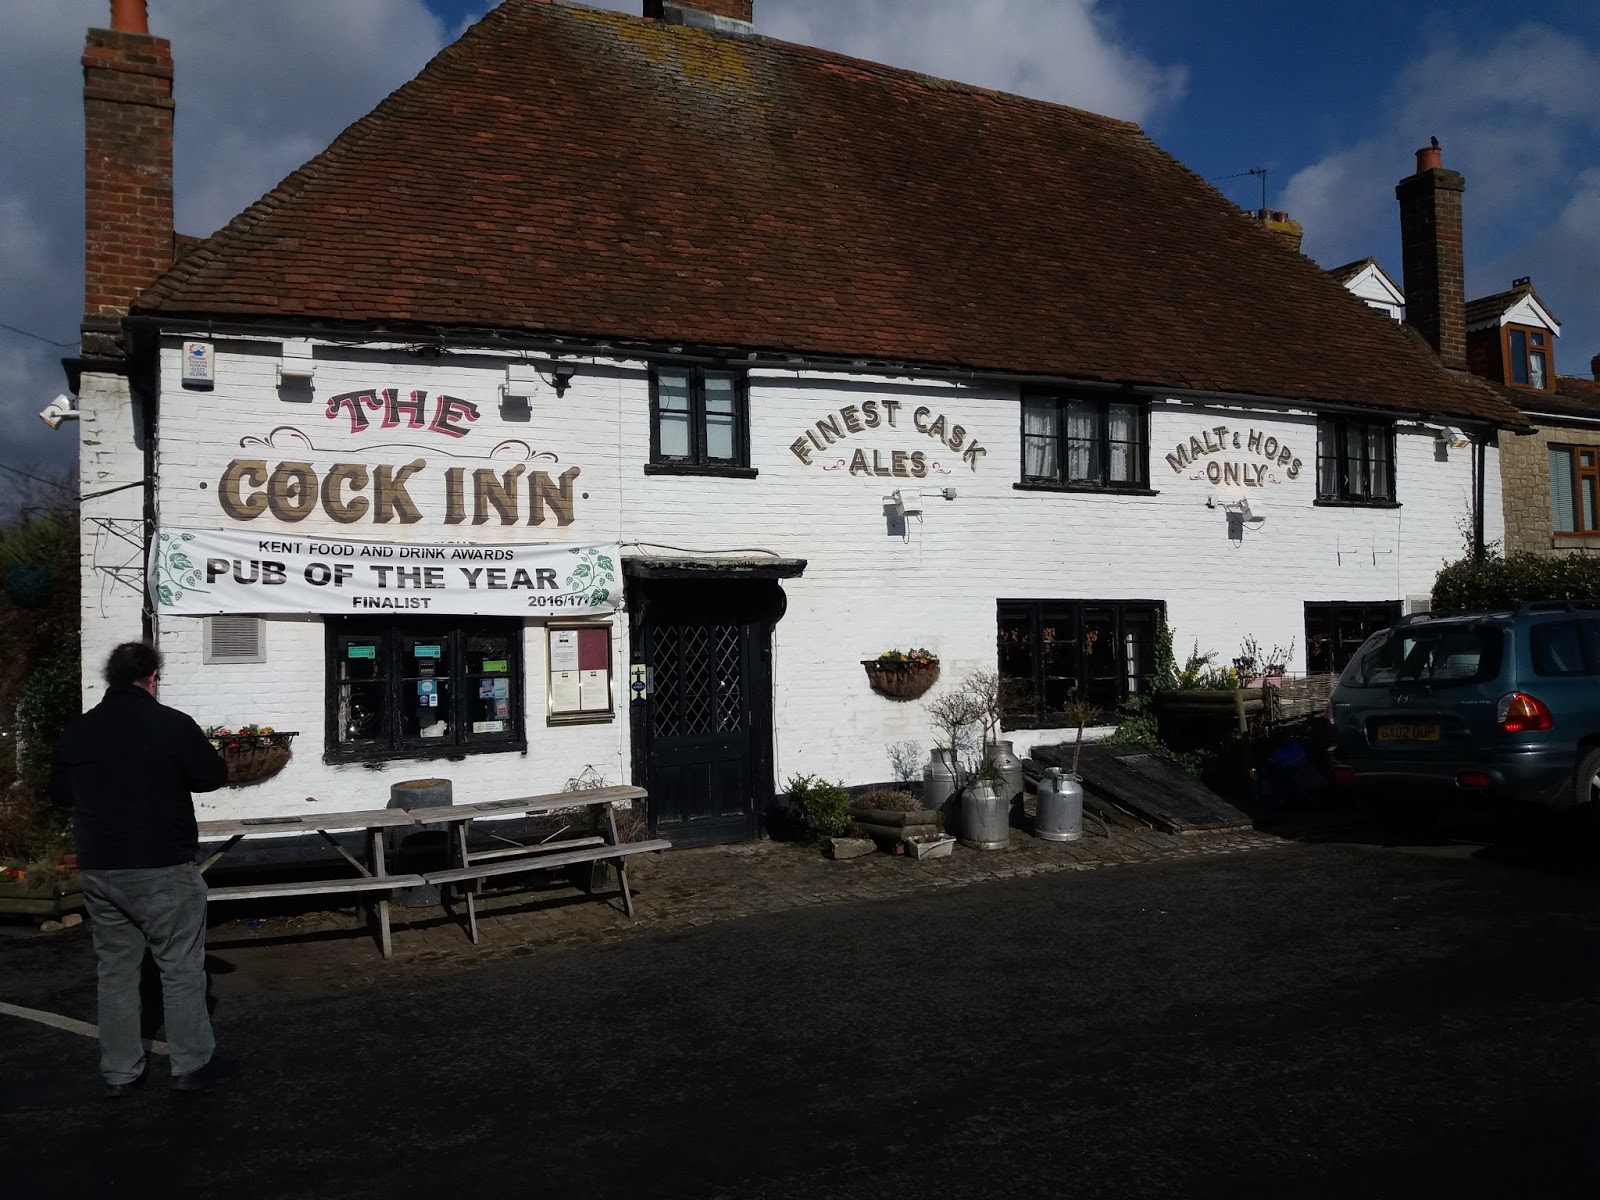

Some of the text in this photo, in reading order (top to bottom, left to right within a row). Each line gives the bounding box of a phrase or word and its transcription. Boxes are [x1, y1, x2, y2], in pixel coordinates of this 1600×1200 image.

[326, 388, 481, 438] THE
[789, 400, 987, 473] FINEST CASK
[849, 448, 928, 478] ALES
[1165, 425, 1303, 480] MALT & HOPS
[1206, 460, 1269, 487] ONLY
[218, 458, 581, 526] COCK INN
[259, 540, 515, 561] KENT FOOD AND DRINK AWARDS
[206, 557, 560, 590] PUB OF THE YEAR
[352, 596, 431, 609] FINALIST
[528, 595, 583, 607] 2016/17
